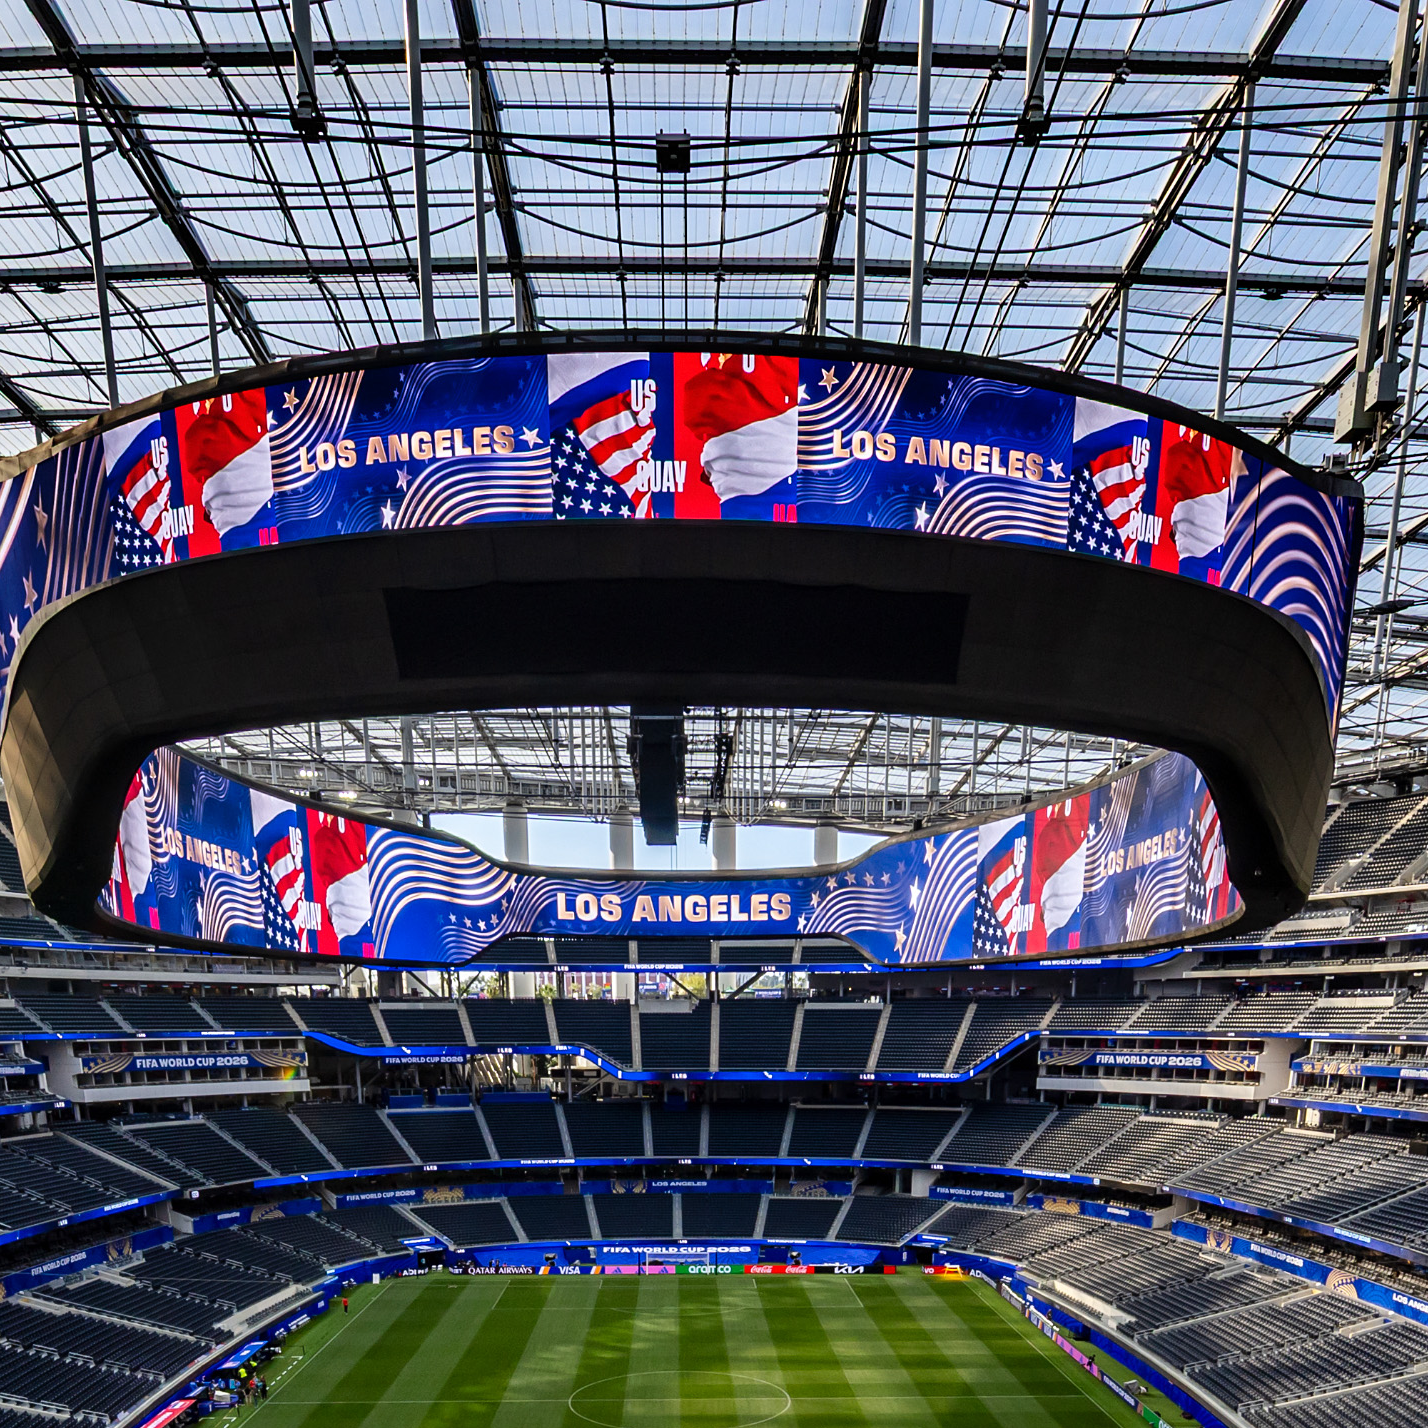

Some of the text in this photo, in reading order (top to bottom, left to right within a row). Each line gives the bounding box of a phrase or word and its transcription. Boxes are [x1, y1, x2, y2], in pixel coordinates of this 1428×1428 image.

[299, 425, 515, 472] LOS ANGELES
[832, 429, 1044, 480] LOS ANGELES
[162, 827, 242, 875] LOS ANGELES
[1101, 828, 1178, 877] LOS ANGELES
[556, 893, 791, 921] LOS ANGELES
[136, 1056, 248, 1068] FIFA WORLD CUP 2026
[1096, 1055, 1202, 1066] FIFA WORLD CUP 2026
[468, 1267, 495, 1275] QATAR
[498, 1266, 533, 1274] AIRWAYS
[558, 1266, 581, 1274] VISA
[688, 1265, 731, 1273] aramco
[1392, 1293, 1409, 1305] LOS
